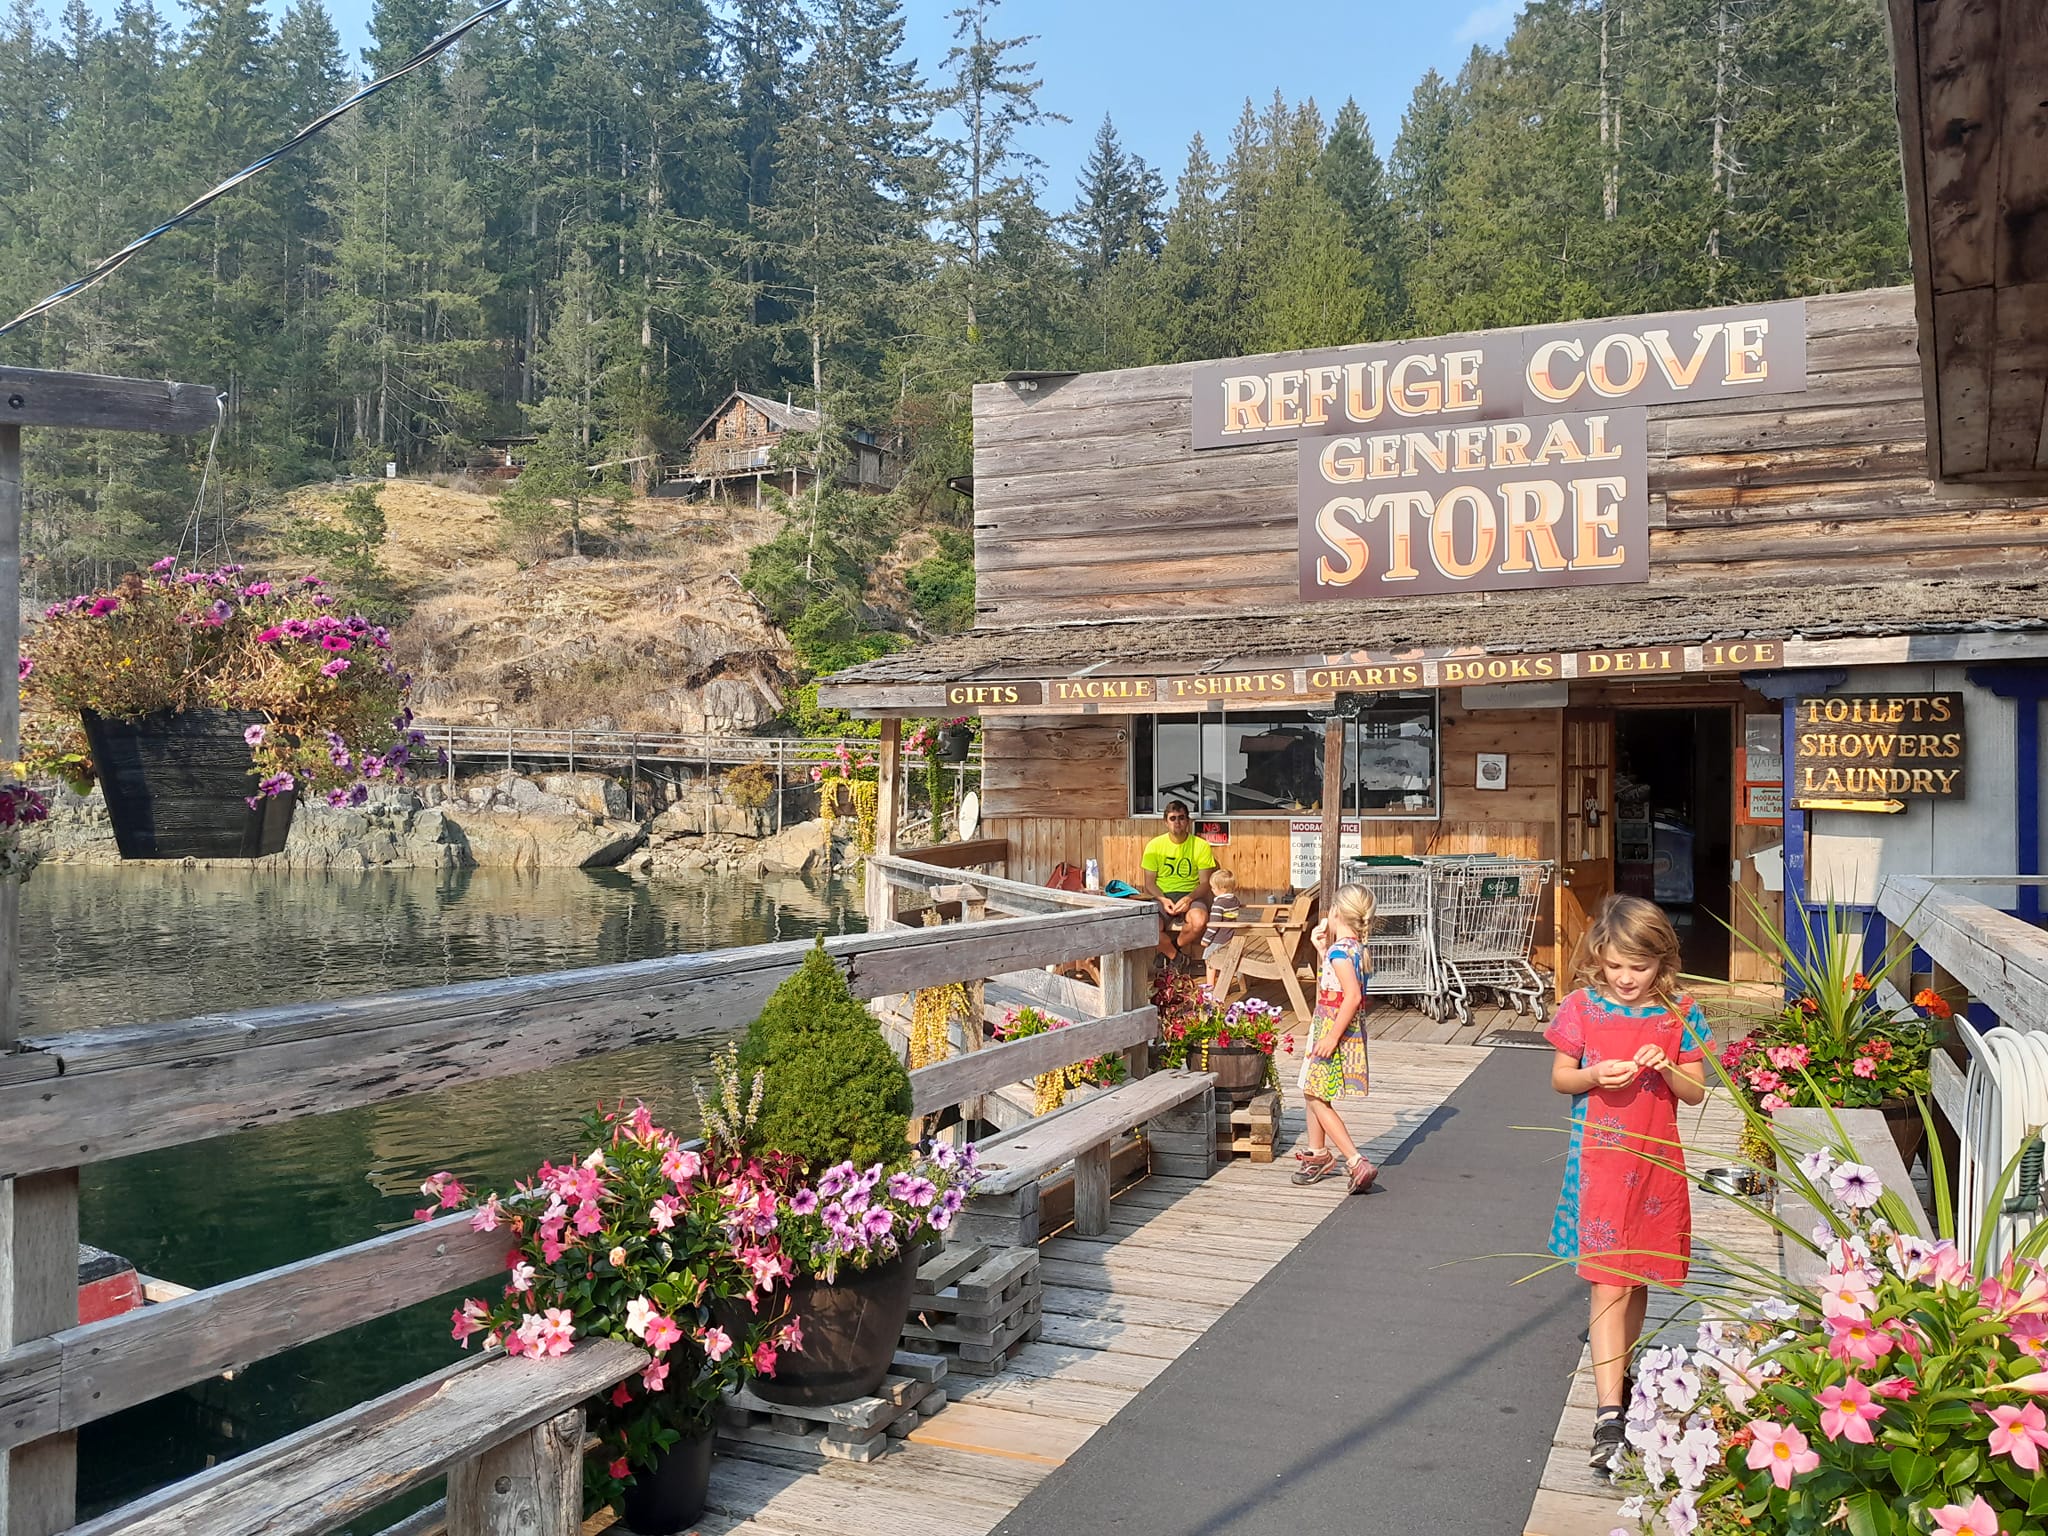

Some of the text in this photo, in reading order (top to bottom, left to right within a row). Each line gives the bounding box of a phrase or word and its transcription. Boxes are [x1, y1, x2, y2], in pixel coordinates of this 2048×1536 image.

[1220, 318, 1770, 435] REFUGE COVE
[1319, 415, 1622, 484] GENERAL
[1316, 476, 1627, 587] STORE
[1587, 651, 1672, 673] DELI
[1713, 643, 1775, 665] ICE
[1312, 665, 1418, 688] CHARTS
[1445, 657, 1553, 681] BOOKS
[950, 686, 1018, 704] GIFTS
[1055, 680, 1152, 699] TACKLE
[1802, 696, 1951, 723] TOILETS
[1800, 733, 1961, 758] SHOWERS
[1803, 767, 1960, 794] LAUNDRY
[1203, 823, 1221, 832] NO
[1292, 823, 1358, 832] MOORA TICE
[1164, 857, 1192, 878] 50
